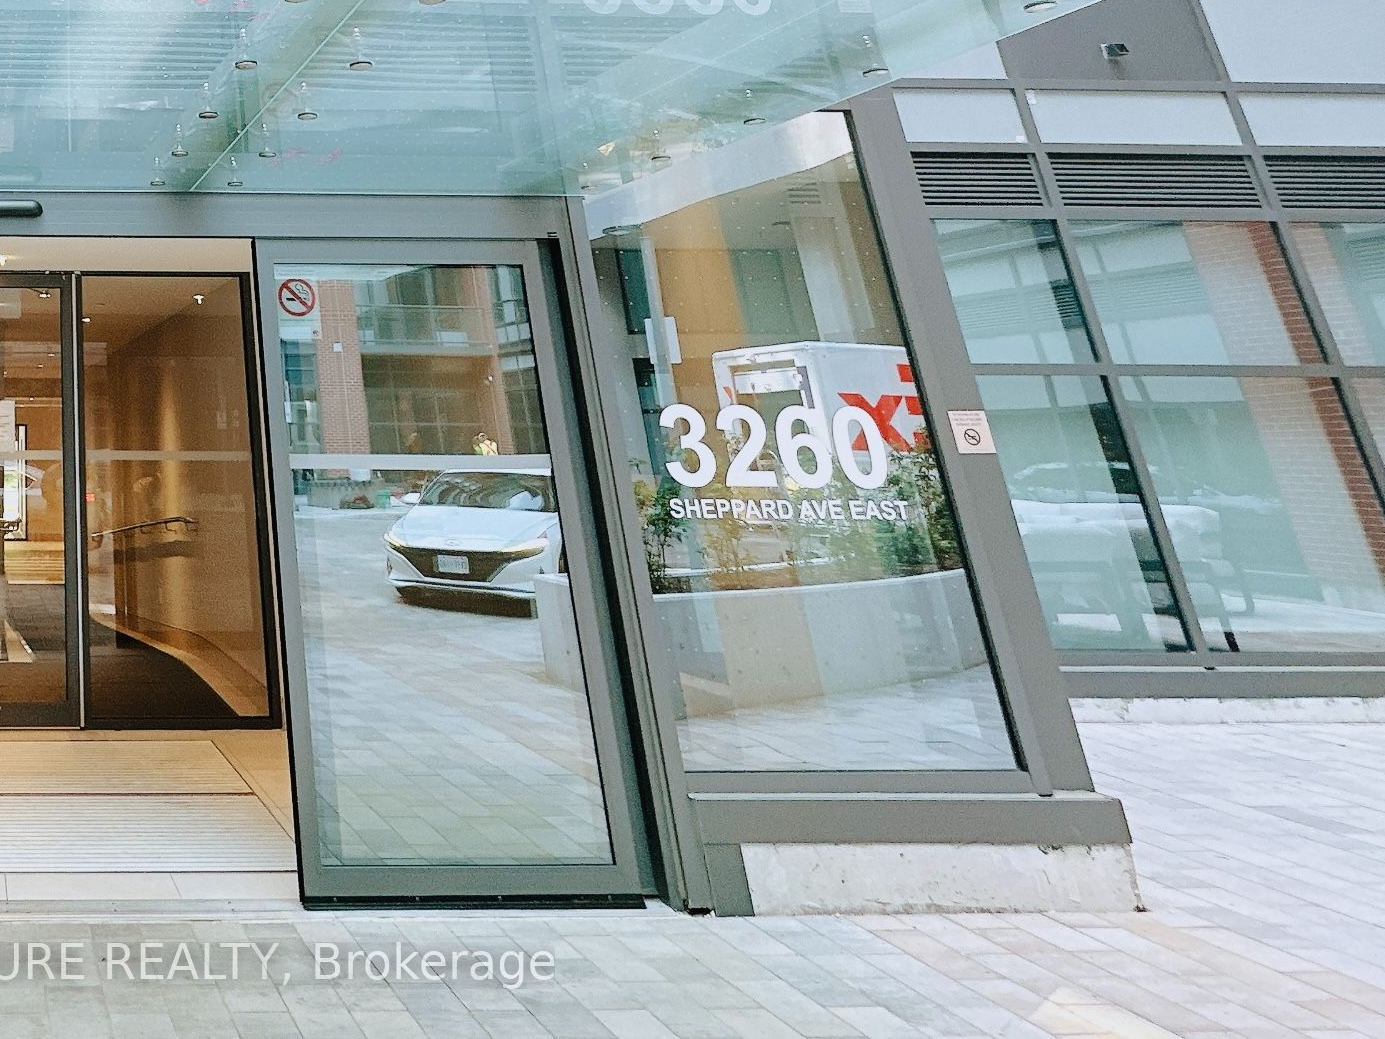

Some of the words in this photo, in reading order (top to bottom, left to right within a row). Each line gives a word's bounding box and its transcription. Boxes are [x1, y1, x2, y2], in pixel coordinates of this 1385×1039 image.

[659, 403, 888, 490] 3260
[669, 497, 793, 520] SHEPPARD
[797, 499, 845, 521] AVE
[849, 500, 909, 522] EAST
